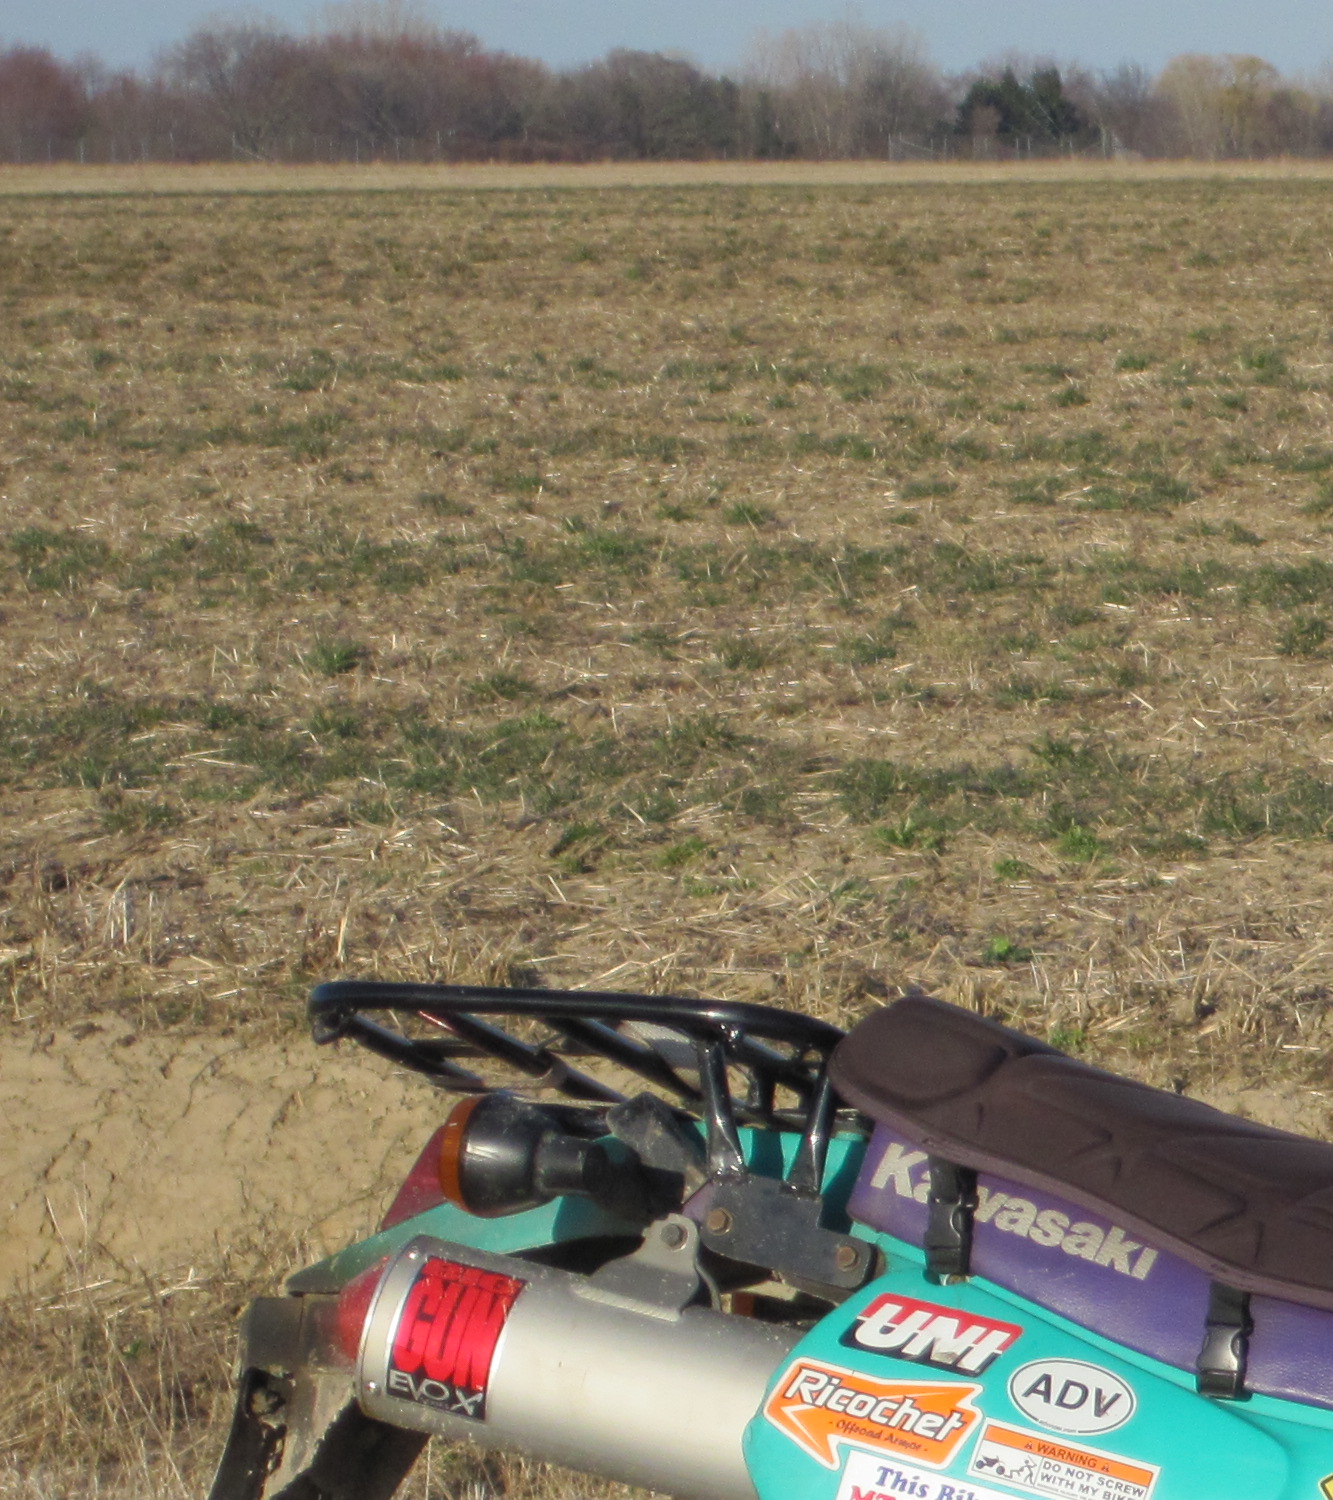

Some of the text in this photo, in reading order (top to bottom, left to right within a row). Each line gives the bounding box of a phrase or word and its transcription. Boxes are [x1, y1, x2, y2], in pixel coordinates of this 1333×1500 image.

[393, 1274, 516, 1392] GUN
[856, 1302, 1010, 1372] UNI
[785, 1368, 967, 1442] Ricochet
[1024, 1373, 1122, 1418] ADV
[836, 1419, 883, 1439] Offroad
[1036, 1442, 1098, 1469] WARNING
[875, 1466, 930, 1498] This
[1040, 1472, 1076, 1490] WITH
[1079, 1484, 1099, 1497] MY
[1042, 1461, 1144, 1498] DO NOT SCREW
